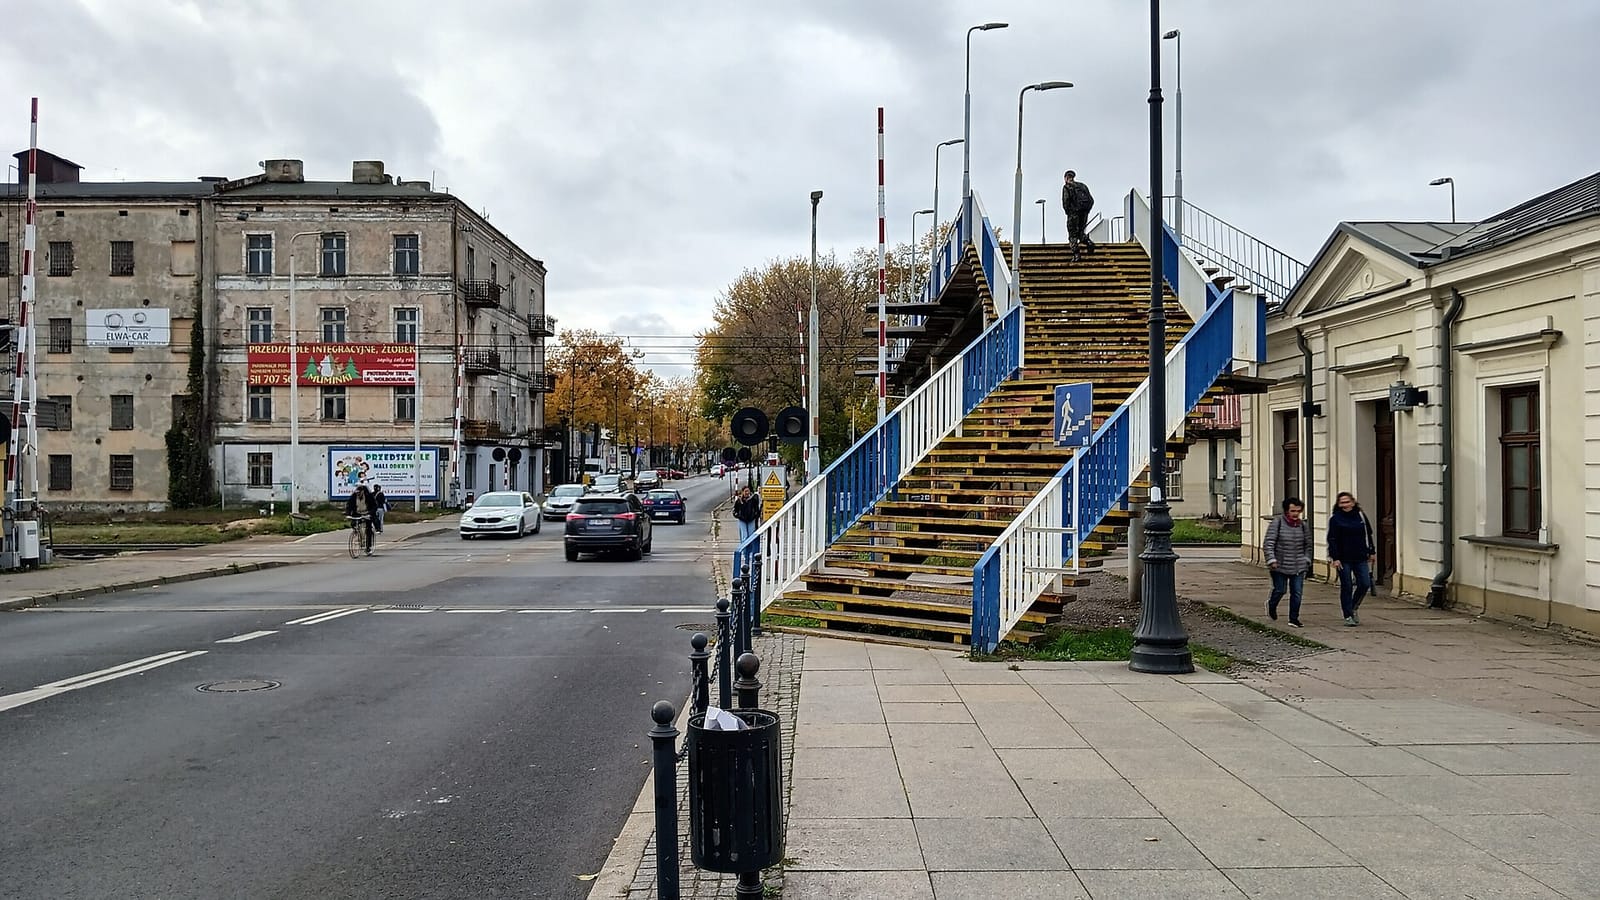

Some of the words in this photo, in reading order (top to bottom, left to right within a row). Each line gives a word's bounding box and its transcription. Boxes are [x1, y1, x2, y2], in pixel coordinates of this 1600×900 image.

[106, 332, 149, 340] ELWA-CAR
[312, 345, 379, 355] INTEGRACYJNE,
[250, 375, 261, 384] 511
[263, 375, 280, 384] 707
